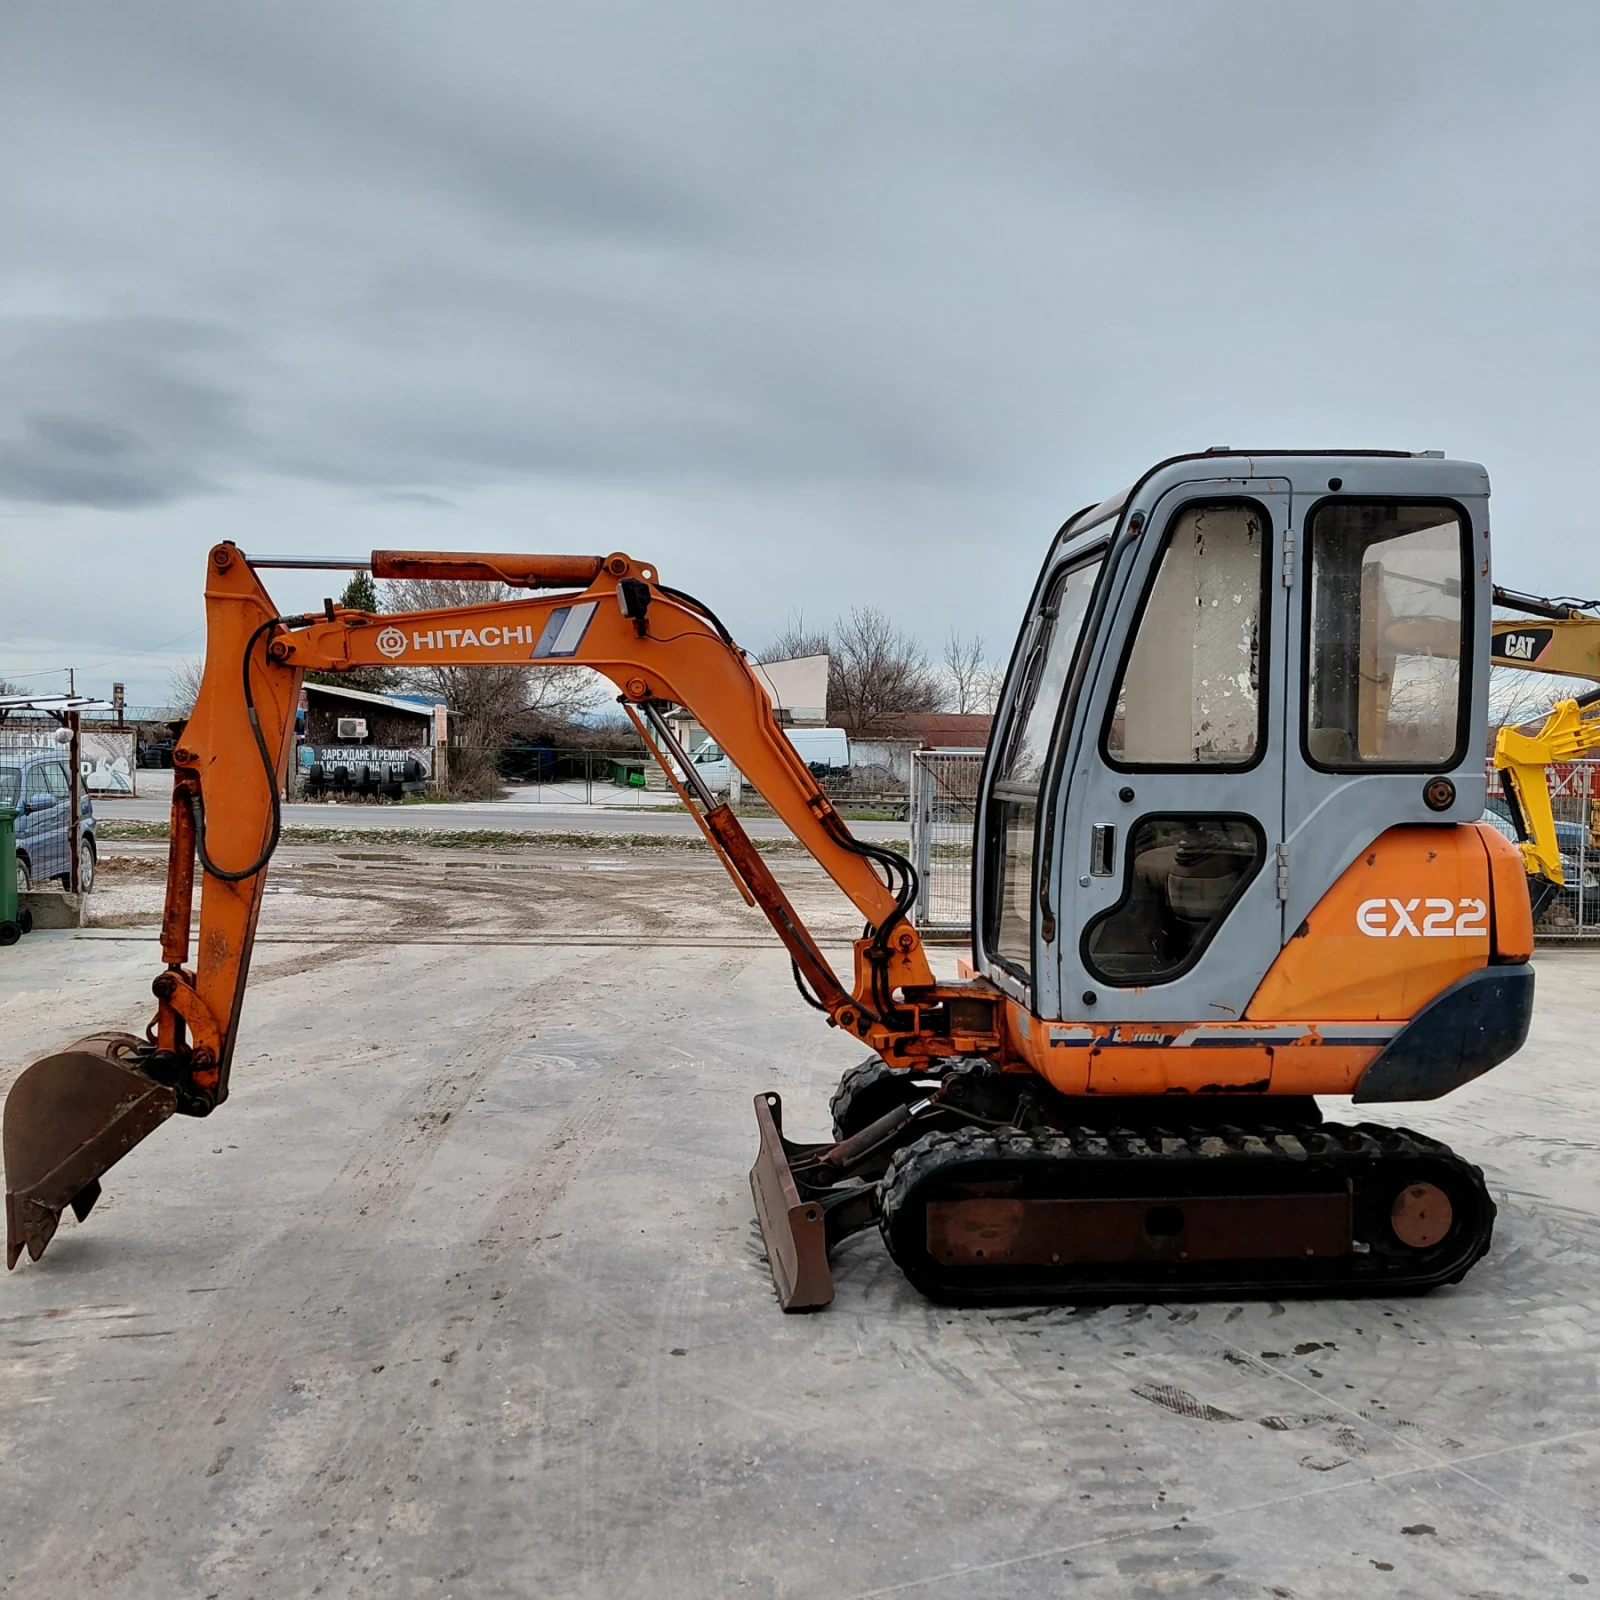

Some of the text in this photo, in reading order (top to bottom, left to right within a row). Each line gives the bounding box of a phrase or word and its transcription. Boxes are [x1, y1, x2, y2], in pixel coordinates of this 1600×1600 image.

[412, 625, 533, 650] HITACHI
[1505, 634, 1536, 659] CAT
[321, 749, 370, 761] ЗАРЕЖДАНЕ
[380, 750, 410, 761] РЕМОНТ
[1356, 898, 1487, 937] EX22
